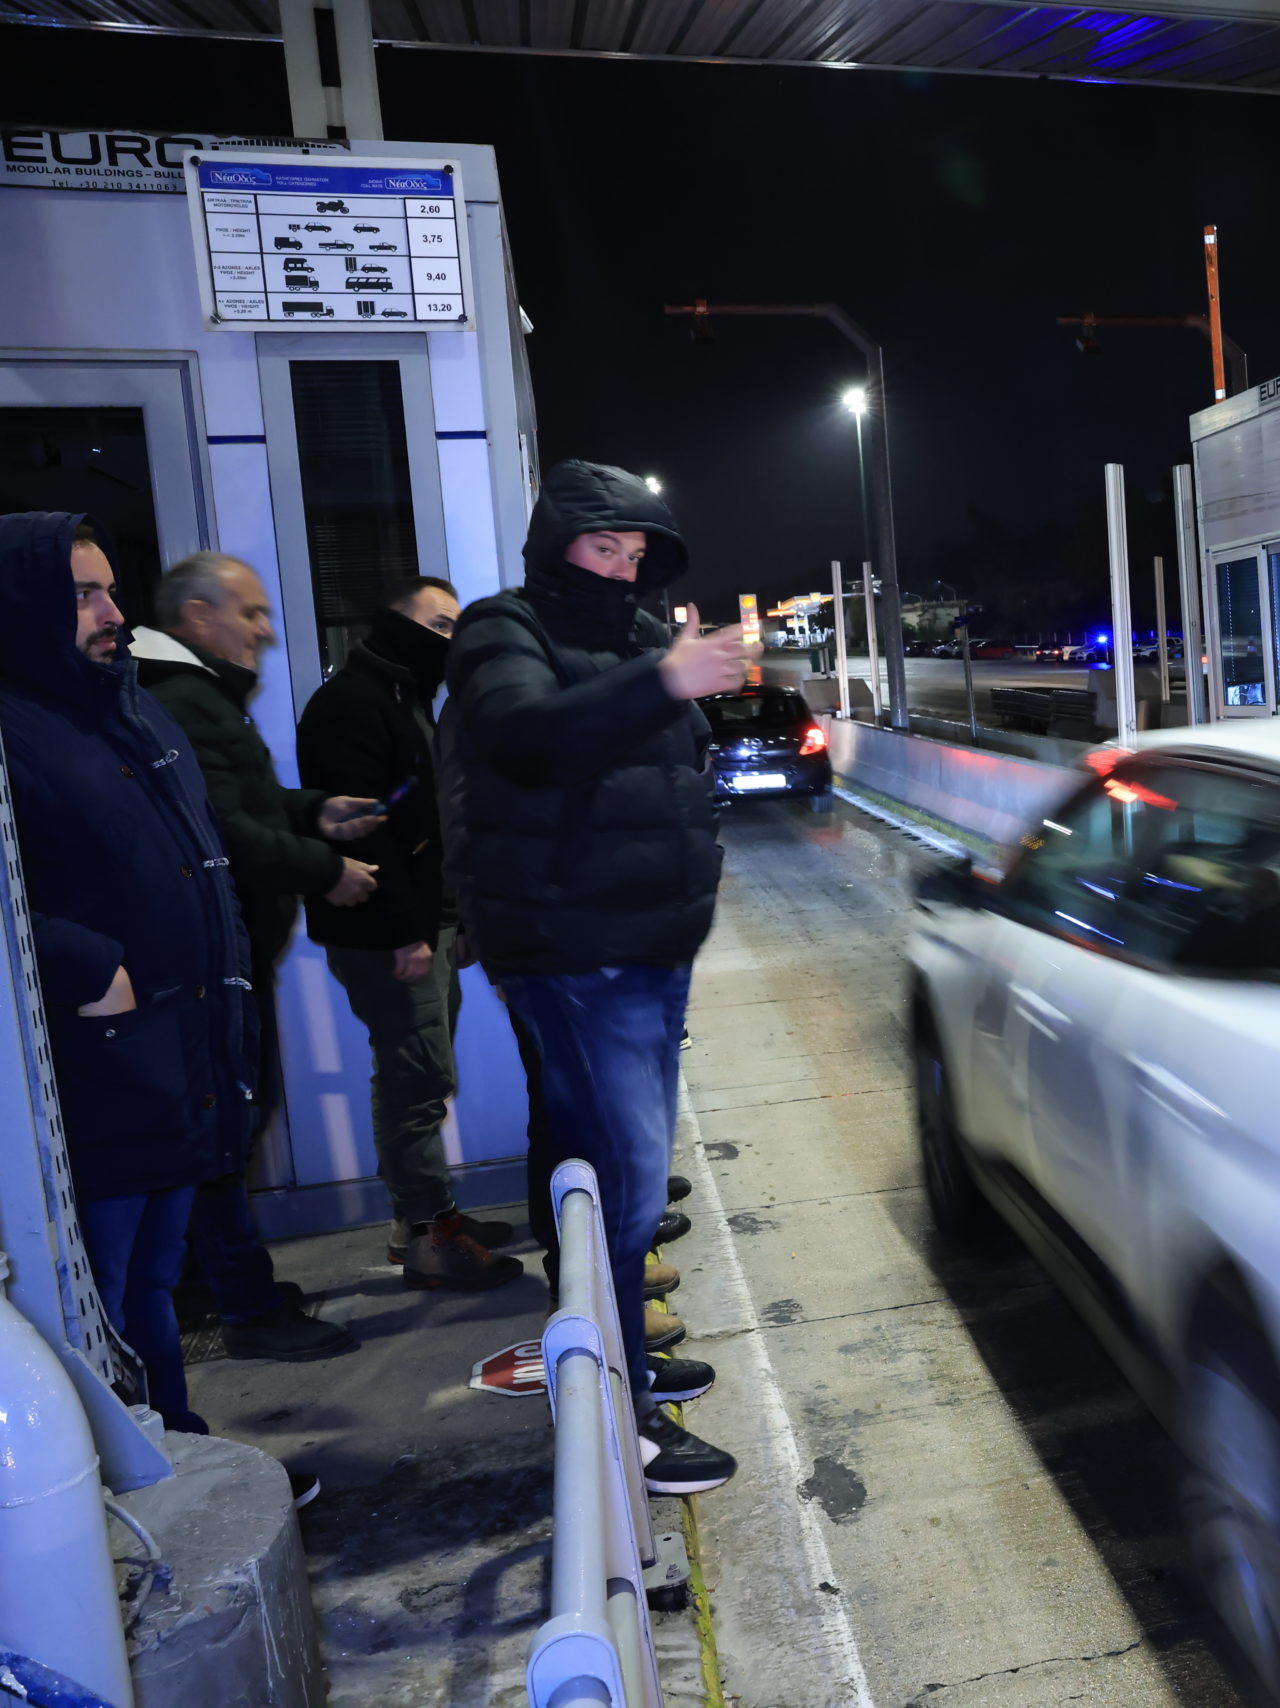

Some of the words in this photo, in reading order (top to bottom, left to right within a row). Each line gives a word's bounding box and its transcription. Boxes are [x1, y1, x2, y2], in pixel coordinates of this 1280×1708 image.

[6, 164, 71, 176] MODULAR
[75, 167, 144, 178] BUILDINGS
[103, 182, 122, 190] 210
[420, 205, 441, 214] 2,60
[422, 234, 443, 244] 3,75
[426, 272, 447, 281] 9,40
[427, 303, 452, 312] 13,20
